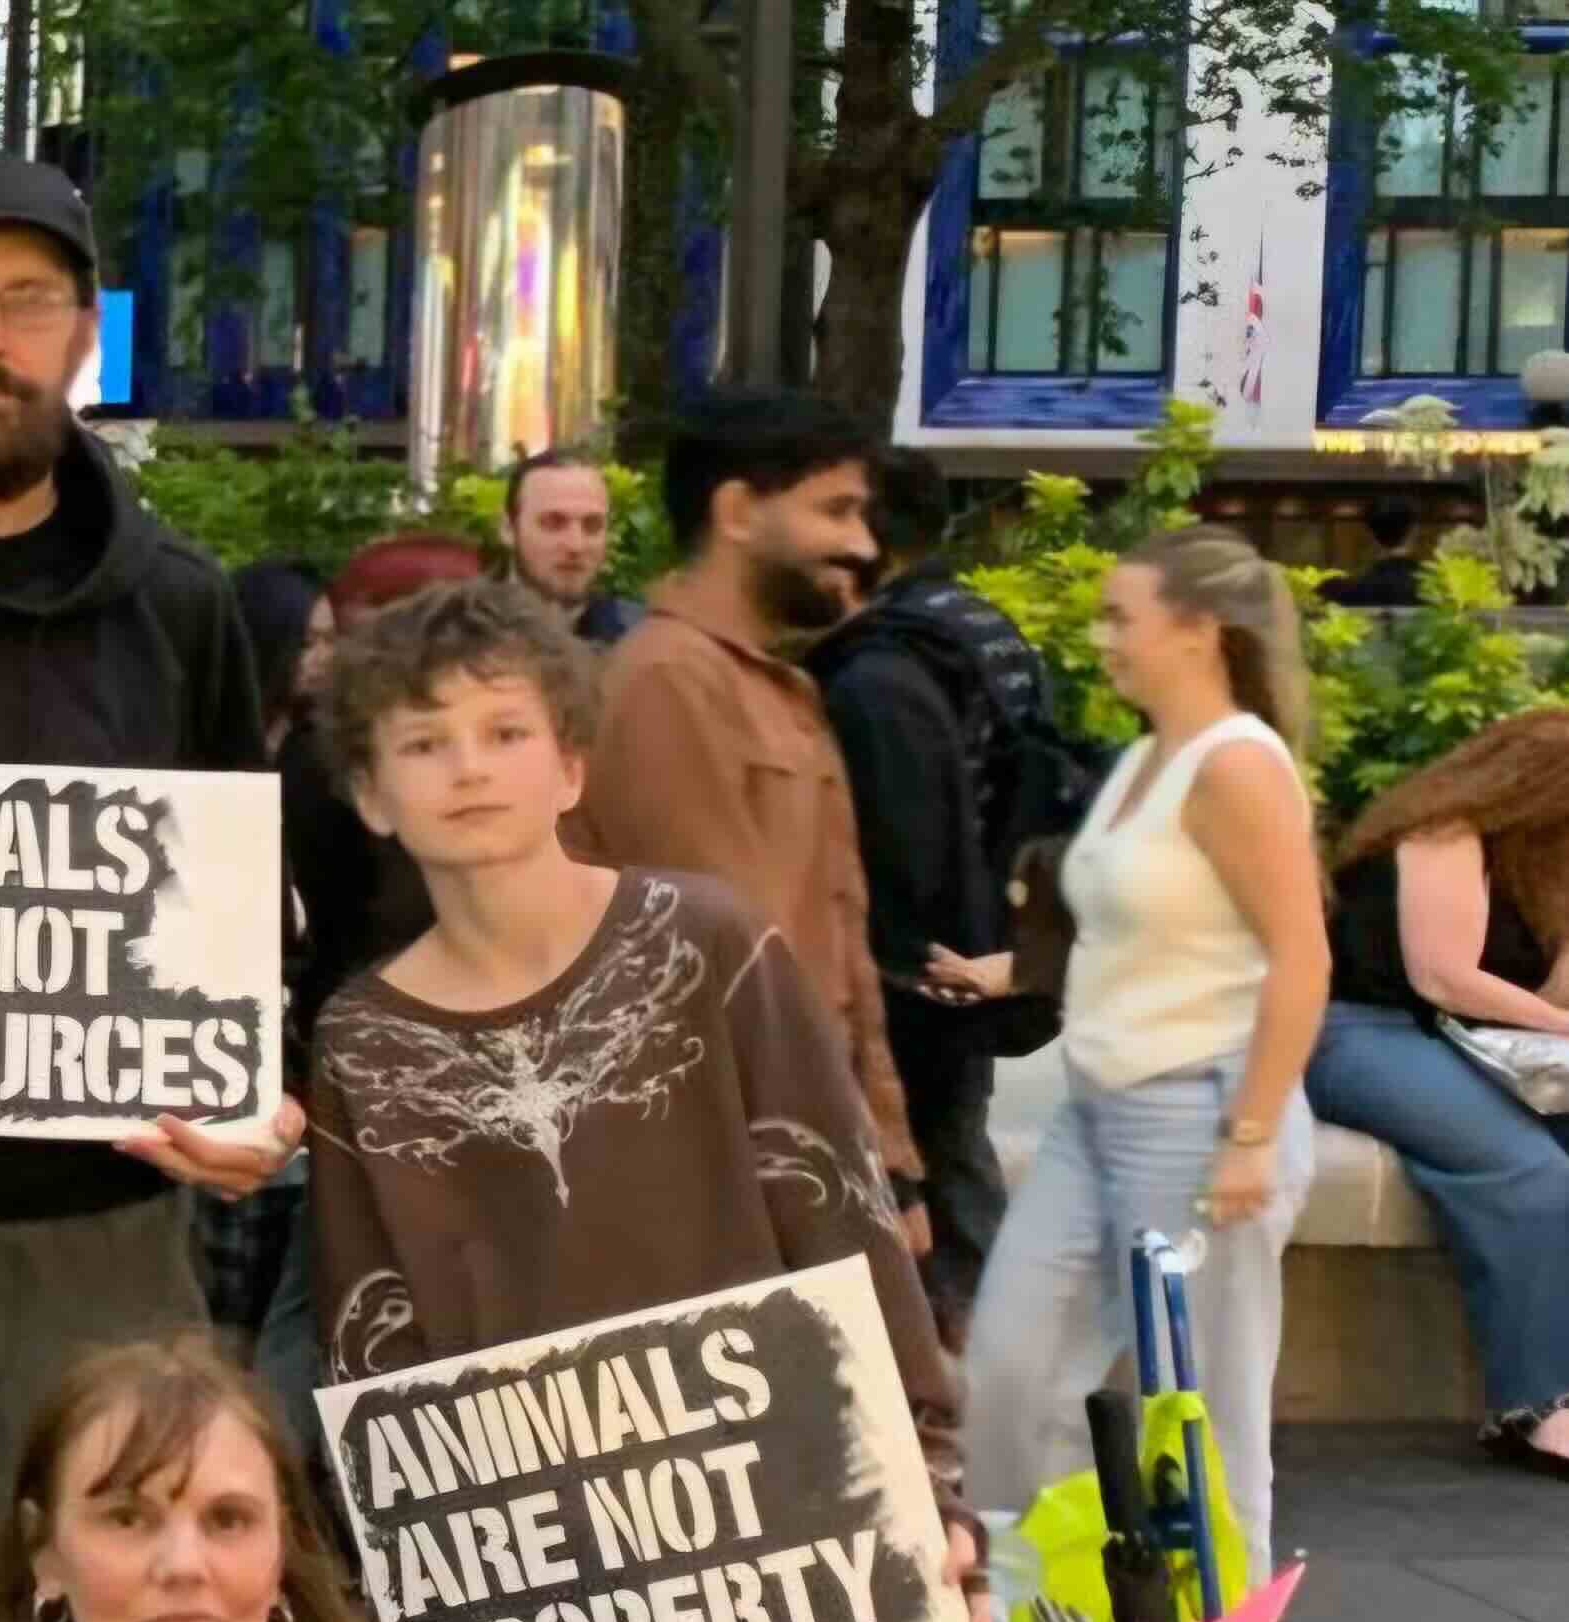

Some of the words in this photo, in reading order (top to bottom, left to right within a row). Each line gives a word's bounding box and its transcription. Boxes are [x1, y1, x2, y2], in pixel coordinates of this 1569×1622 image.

[365, 1328, 770, 1509] ANIMALS
[397, 1495, 579, 1618] ARE
[582, 1441, 761, 1570] NOT
